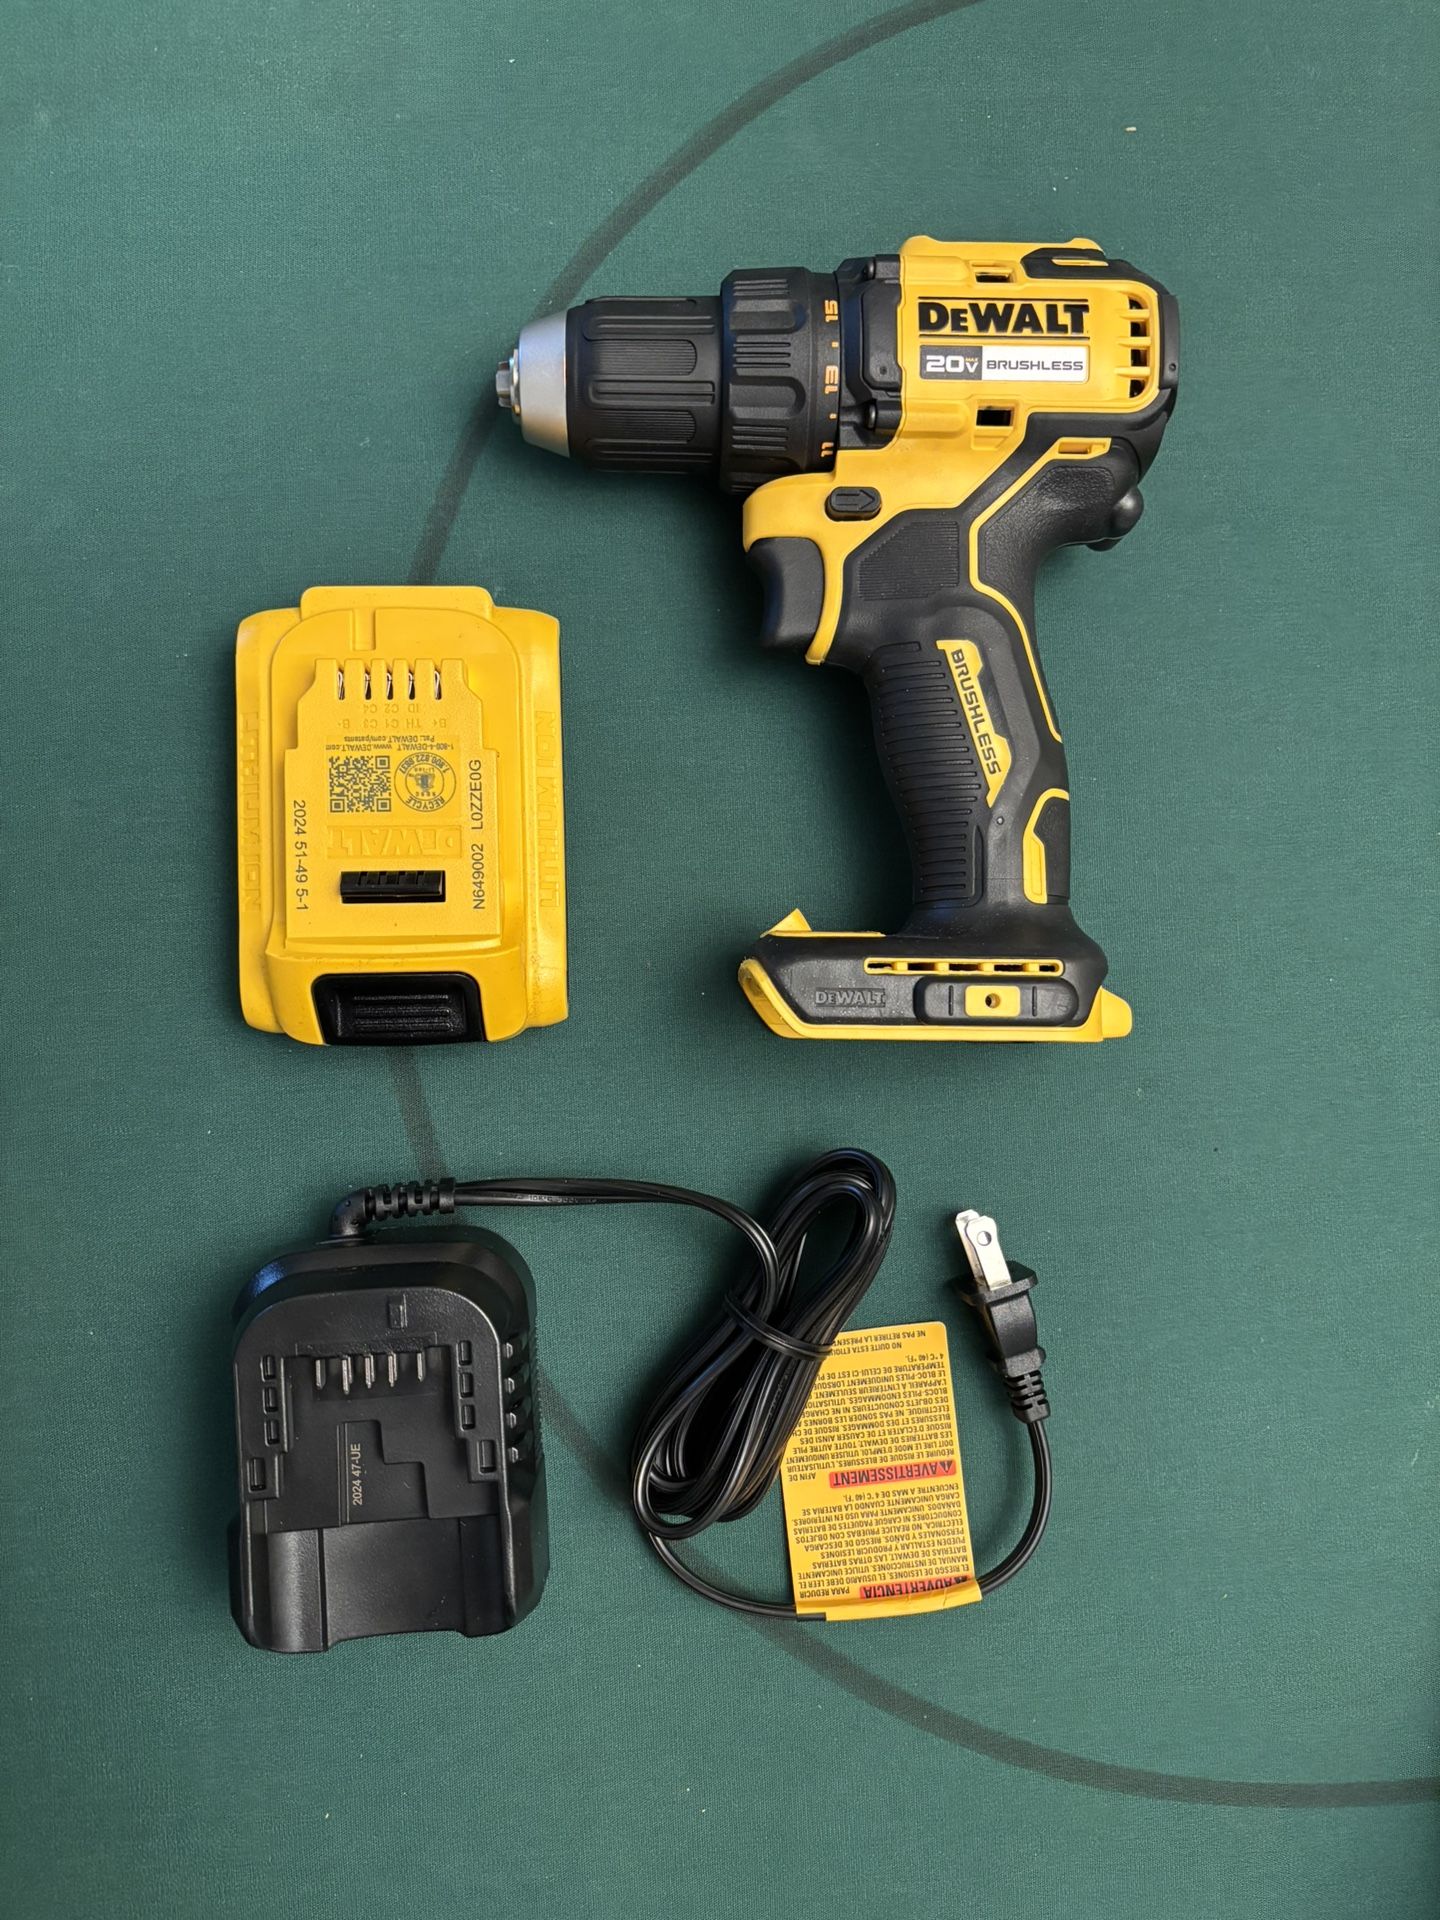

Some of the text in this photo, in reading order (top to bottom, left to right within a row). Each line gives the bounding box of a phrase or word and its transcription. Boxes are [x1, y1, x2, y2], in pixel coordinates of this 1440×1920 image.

[824, 299, 839, 323] 15
[917, 302, 1090, 334] DEWALT
[986, 360, 1084, 371] BRUSHLESS
[824, 365, 839, 394] 13
[820, 442, 835, 458] 11
[951, 649, 1002, 775] BRUSHLESS
[325, 743, 392, 752] www.DEWALT.com
[405, 795, 447, 810] RECYCLE
[328, 827, 460, 857] DEWALT
[293, 800, 309, 911] 2024 51-49 5-1
[472, 842, 486, 910] N649002
[815, 990, 886, 1005] DEWALT
[872, 1332, 900, 1342] RETIRER
[917, 1329, 925, 1337] NE
[863, 1335, 872, 1343] LA
[851, 1341, 901, 1353] NO QUITE ESTA
[837, 1370, 850, 1378] EST
[936, 1369, 945, 1377] LE
[846, 1374, 894, 1386] UNIQUEMENT
[905, 1397, 933, 1407] OBJETS
[934, 1395, 948, 1403] DES
[851, 1400, 904, 1412] CONDUCTEURS
[848, 1412, 877, 1421] SONDER
[878, 1410, 893, 1418] PAS
[893, 1409, 904, 1417] NE
[803, 1416, 832, 1426] BORNES
[833, 1415, 846, 1423] LES
[885, 1418, 899, 1426] DES
[900, 1417, 909, 1425] ET
[910, 1413, 950, 1424] BLESSURES
[802, 1427, 812, 1435] DE
[812, 1425, 839, 1434] RISQUE
[925, 1421, 951, 1431] RISQUE
[836, 1431, 864, 1440] CAUSER
[876, 1428, 885, 1436] ET
[792, 1430, 952, 1454] LES BATTERIES DE TOUTE AUTRE PILE
[799, 1436, 813, 1444] DES
[814, 1434, 835, 1443] AINSI
[785, 1439, 953, 1464] DOIT LIRE LE MODE UTILISER UNIQUEMENT
[889, 1452, 914, 1461] RISQUE
[350, 1443, 363, 1506] 2024 47-UE
[799, 1472, 816, 1480] AFIN
[831, 1462, 938, 1485] AVERTISSEMENT
[891, 1488, 908, 1497] MÁS
[917, 1482, 958, 1493] ENCUENTRE
[801, 1491, 959, 1516] CARGA ÚNICAMENTE CUANDO LA BATERÍA SE
[833, 1513, 843, 1521] EN
[844, 1511, 859, 1520] USO
[859, 1509, 878, 1518] PARA
[791, 1514, 832, 1526] INTERIORES.
[792, 1509, 962, 1536] CONDUCTORES NI CARGUE PAQUETES DE BATERÍAS
[794, 1522, 922, 1544] NO REALICE PRUEBAS CON OBJETOS
[918, 1526, 964, 1538] PERSONALES
[803, 1540, 842, 1551] DESCARGA
[843, 1539, 853, 1547] DE
[855, 1536, 881, 1546] RIESGO
[819, 1535, 965, 1559] PUEDEN ESTALLAR Y PRODUCIR LESIONES
[811, 1545, 966, 1570] BATERÍAS DE LAS OTRAS BATERÍAS
[927, 1557, 936, 1565] DE
[938, 1554, 967, 1564] MANUAL
[843, 1565, 869, 1575] UTILICE
[870, 1558, 926, 1572] INSTRUCCIONES.
[934, 1564, 959, 1574] RIESGO
[961, 1563, 969, 1571] EL
[877, 1572, 885, 1580] EL
[922, 1567, 933, 1575] DE
[807, 1579, 824, 1588] LEER
[825, 1577, 844, 1586] DEBE
[845, 1573, 876, 1584] USUARIO
[798, 1581, 806, 1589] EL
[799, 1577, 952, 1599] ADVERTENCIA PARA REDUCIR
